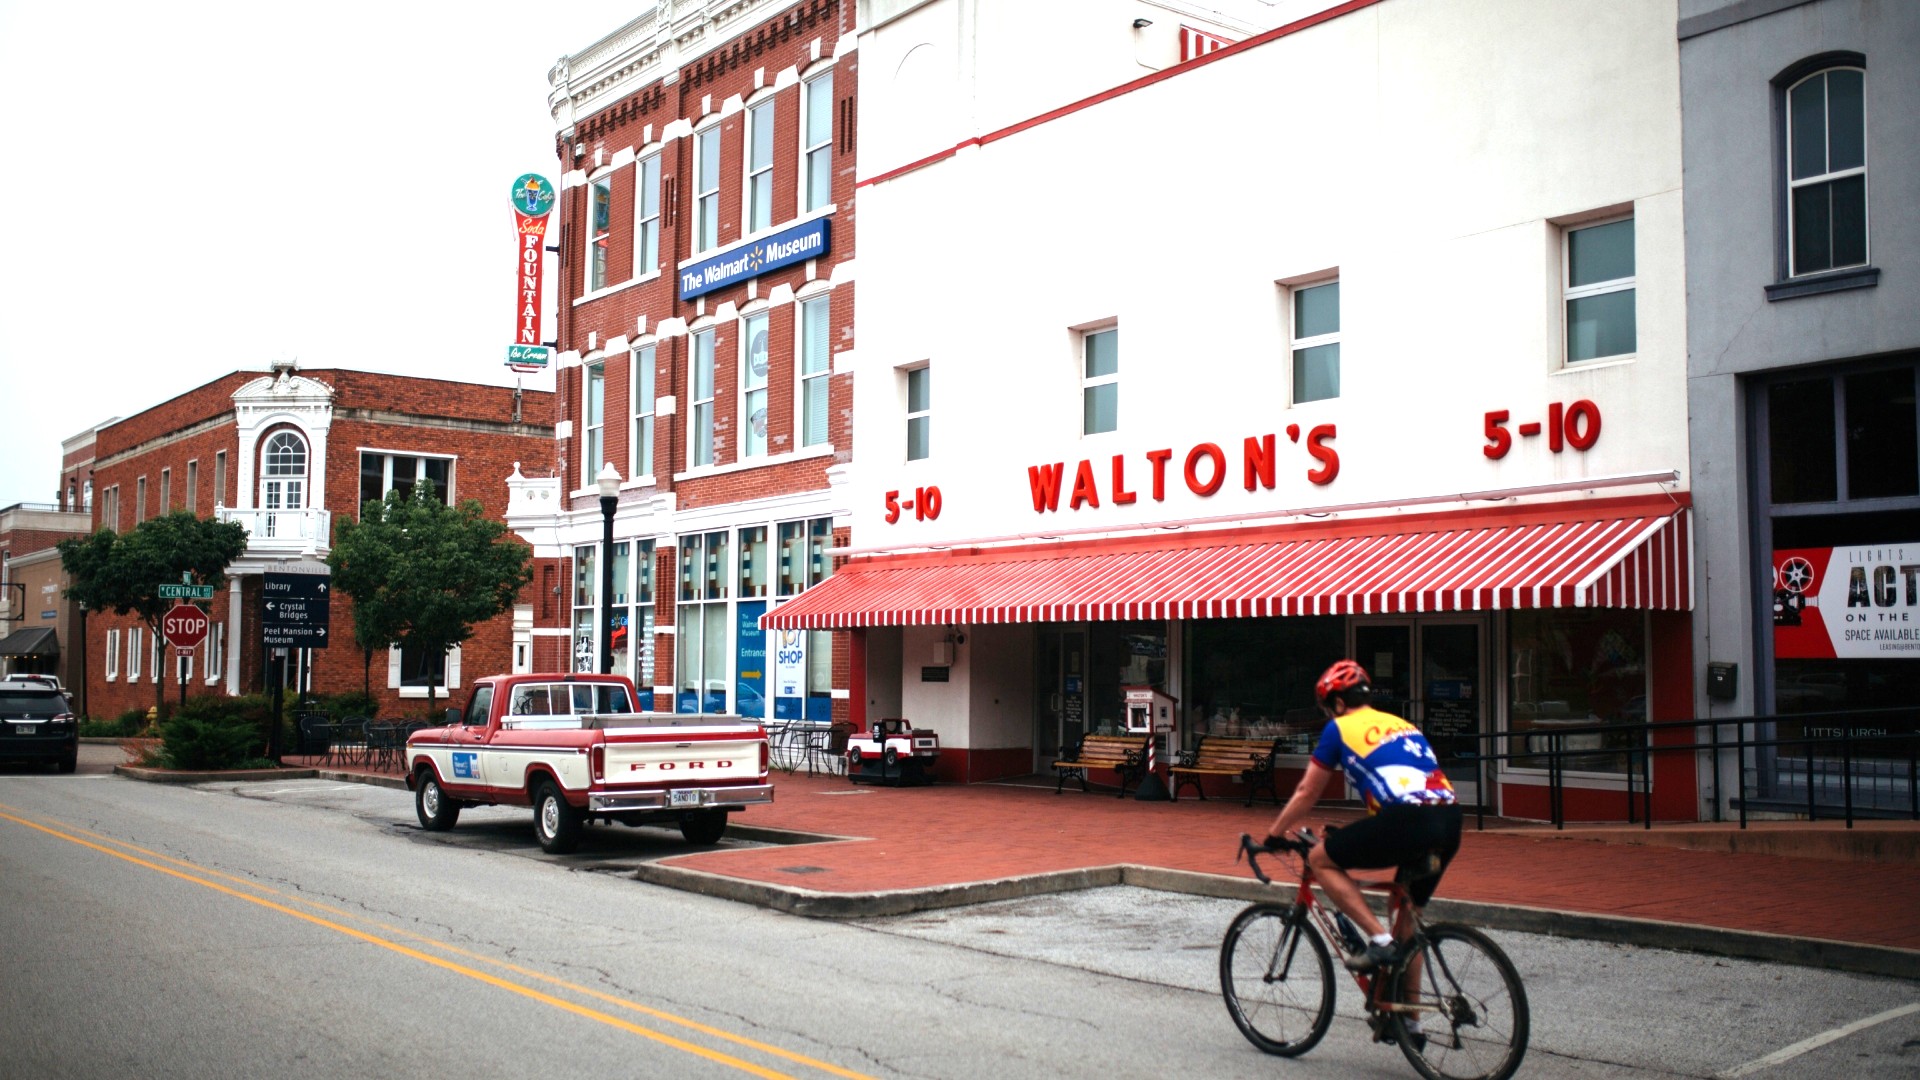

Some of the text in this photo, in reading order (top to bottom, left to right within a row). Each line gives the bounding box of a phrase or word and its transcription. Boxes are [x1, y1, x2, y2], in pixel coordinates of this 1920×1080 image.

[519, 218, 544, 234] Soda
[682, 232, 820, 292] The Walmart Museum
[522, 234, 538, 343] FOUNTAIN
[522, 348, 547, 360] Cream
[1484, 399, 1602, 460] 5-10
[1028, 423, 1340, 514] WALTON'S
[885, 486, 942, 525] 5-10
[166, 587, 201, 597] CENTRAL
[265, 582, 291, 592] Library
[280, 603, 305, 611] Crystal
[280, 612, 308, 620] Bridges
[1846, 613, 1909, 622] ON THE
[166, 618, 205, 634] STOP
[1845, 628, 1920, 640] SPACE AVAILABLE
[741, 648, 766, 657] Entrance
[779, 651, 802, 664] SHOP
[630, 761, 732, 771] FORD
